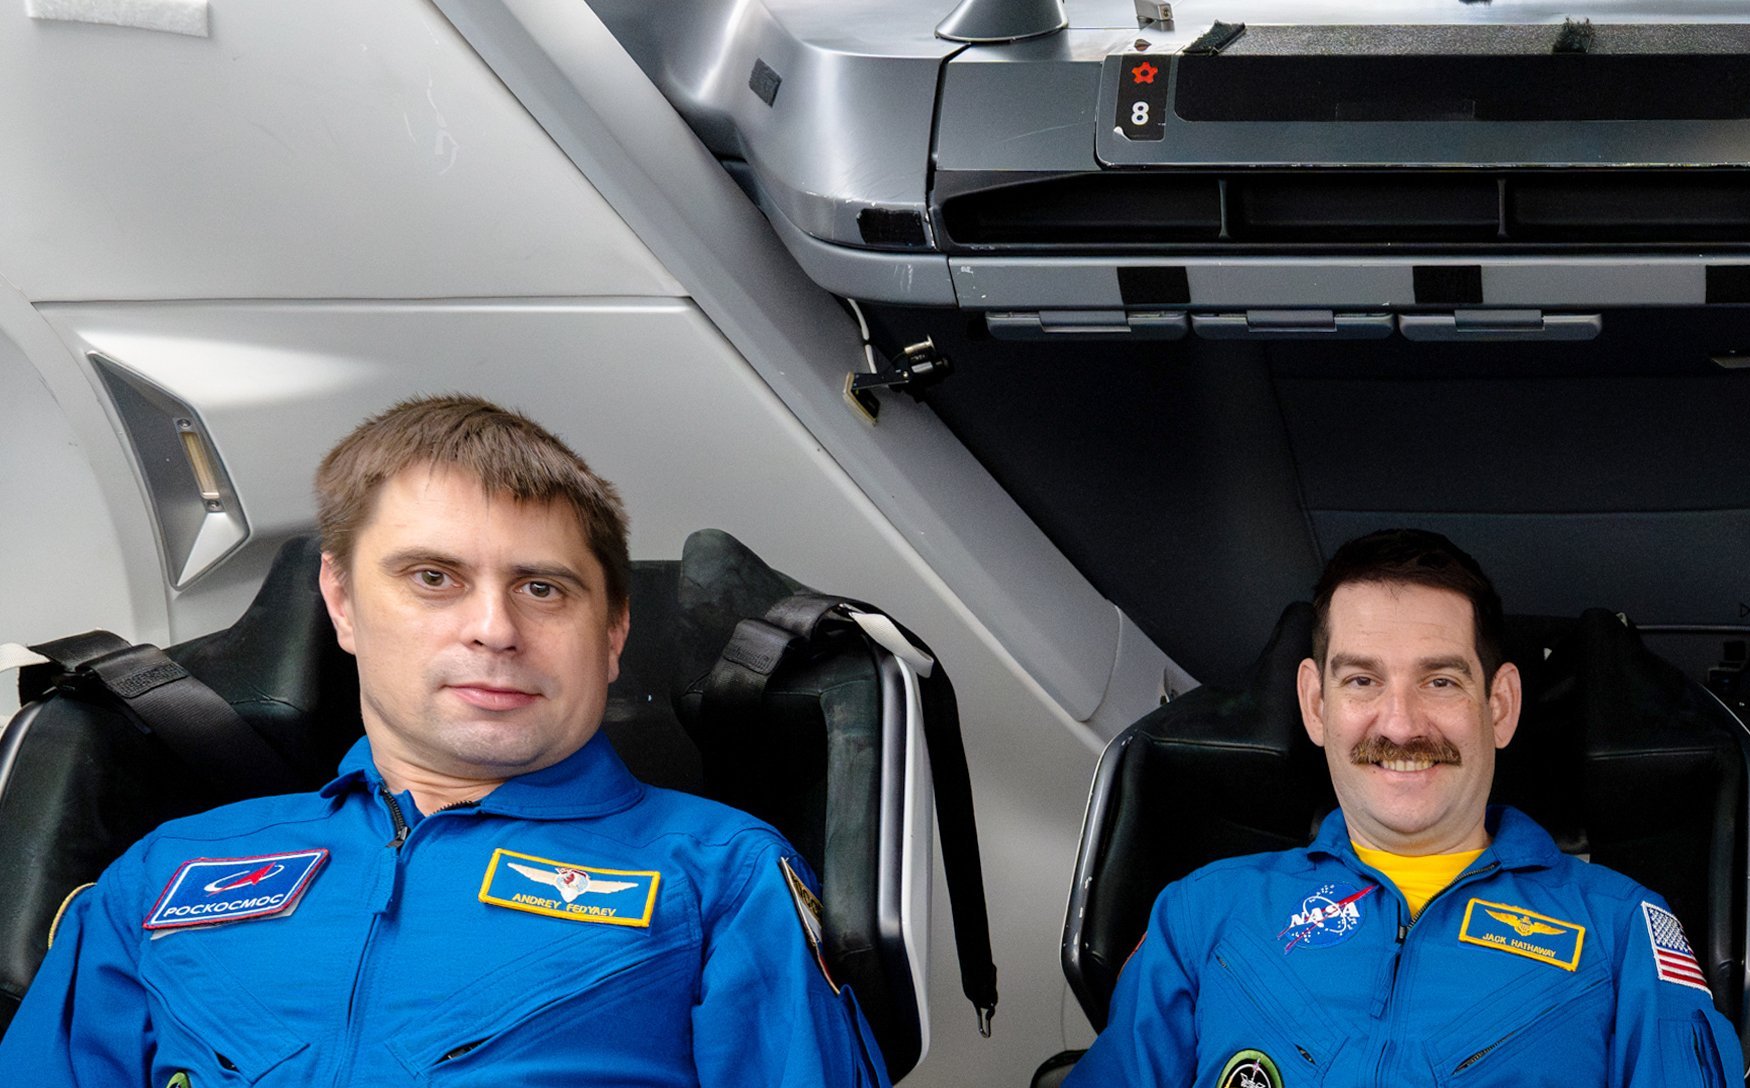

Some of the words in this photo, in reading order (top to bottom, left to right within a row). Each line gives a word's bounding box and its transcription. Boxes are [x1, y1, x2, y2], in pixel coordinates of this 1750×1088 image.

[1131, 101, 1149, 125] 8
[163, 894, 285, 917] РОСКОСМОС
[512, 893, 562, 910] ANDREY
[565, 903, 617, 917] FEDYAEV
[1289, 902, 1360, 928] NASA
[1482, 932, 1507, 945] JACK
[1510, 939, 1557, 958] HATHAWAY
